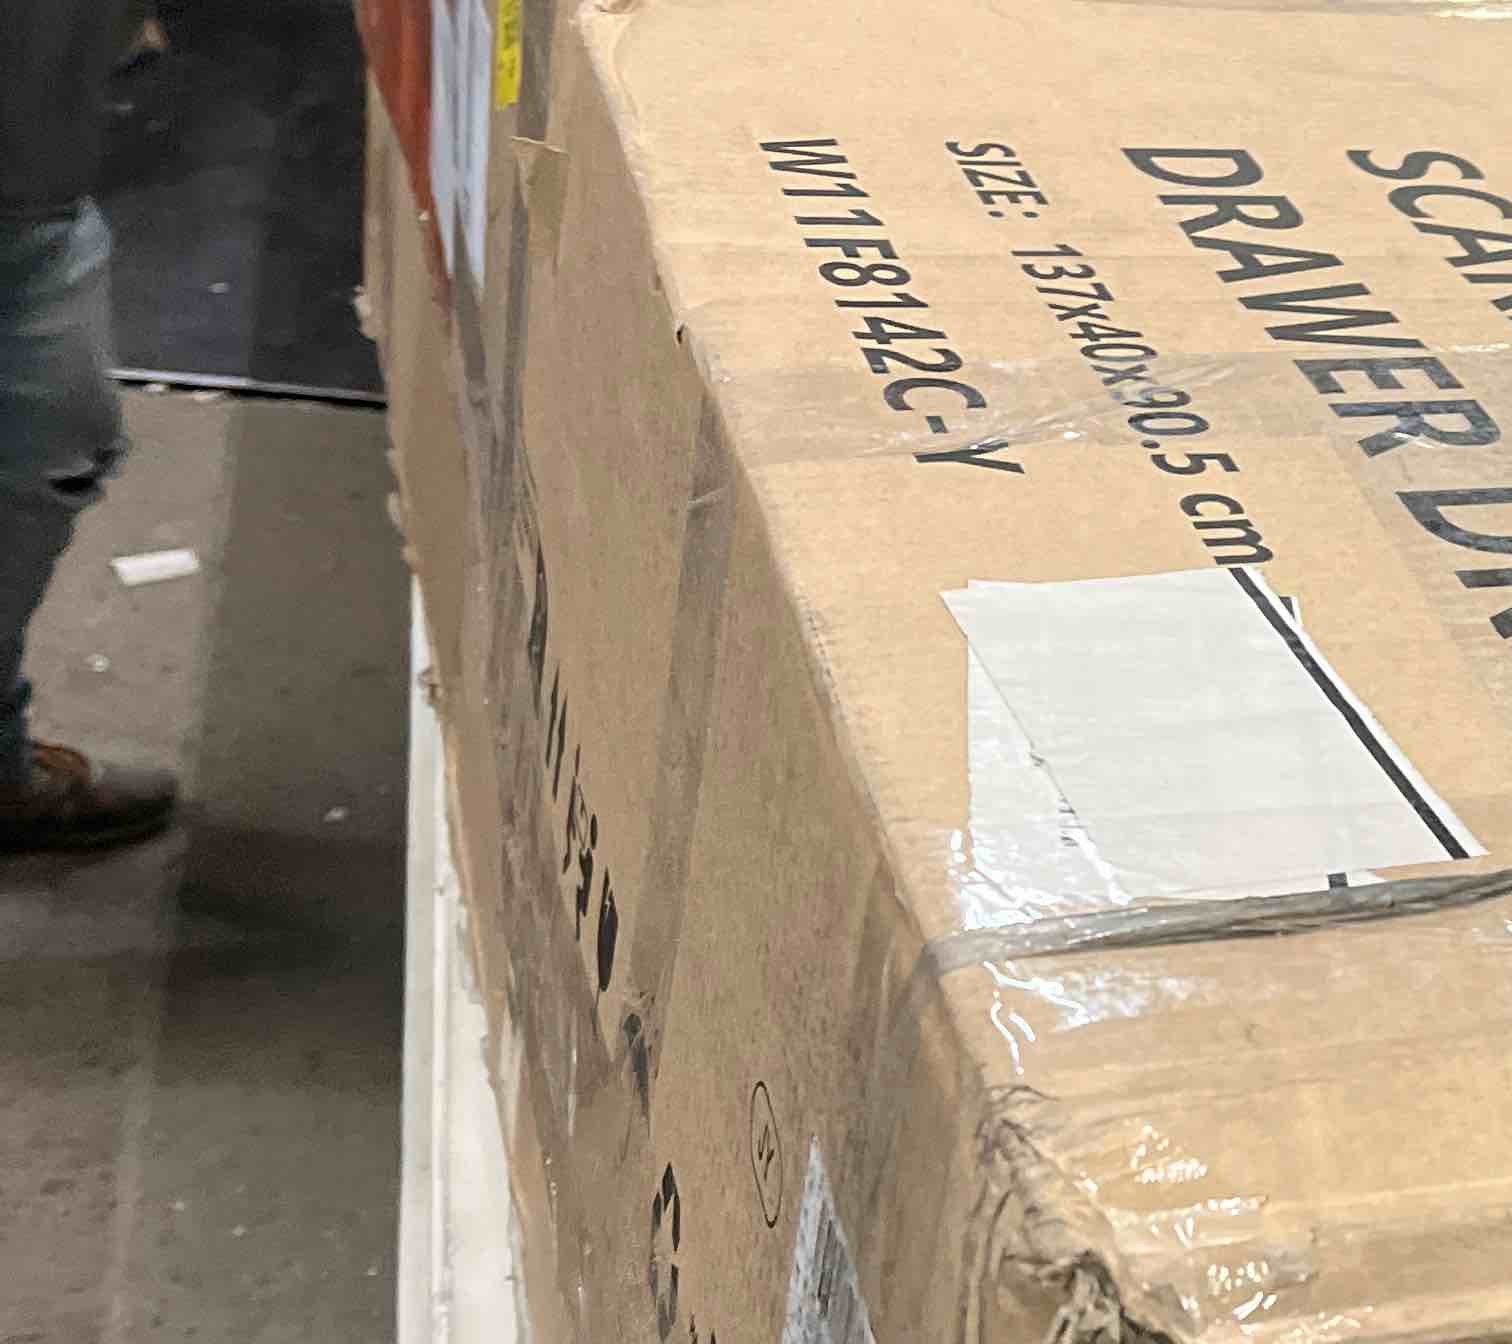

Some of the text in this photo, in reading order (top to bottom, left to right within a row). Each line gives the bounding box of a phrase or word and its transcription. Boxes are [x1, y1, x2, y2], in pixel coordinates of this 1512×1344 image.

[759, 138, 1026, 475] W11F8142C-Y
[945, 140, 1050, 219] SIZE:
[1179, 493, 1274, 566] cm
[1121, 147, 1502, 458] DRAWER
